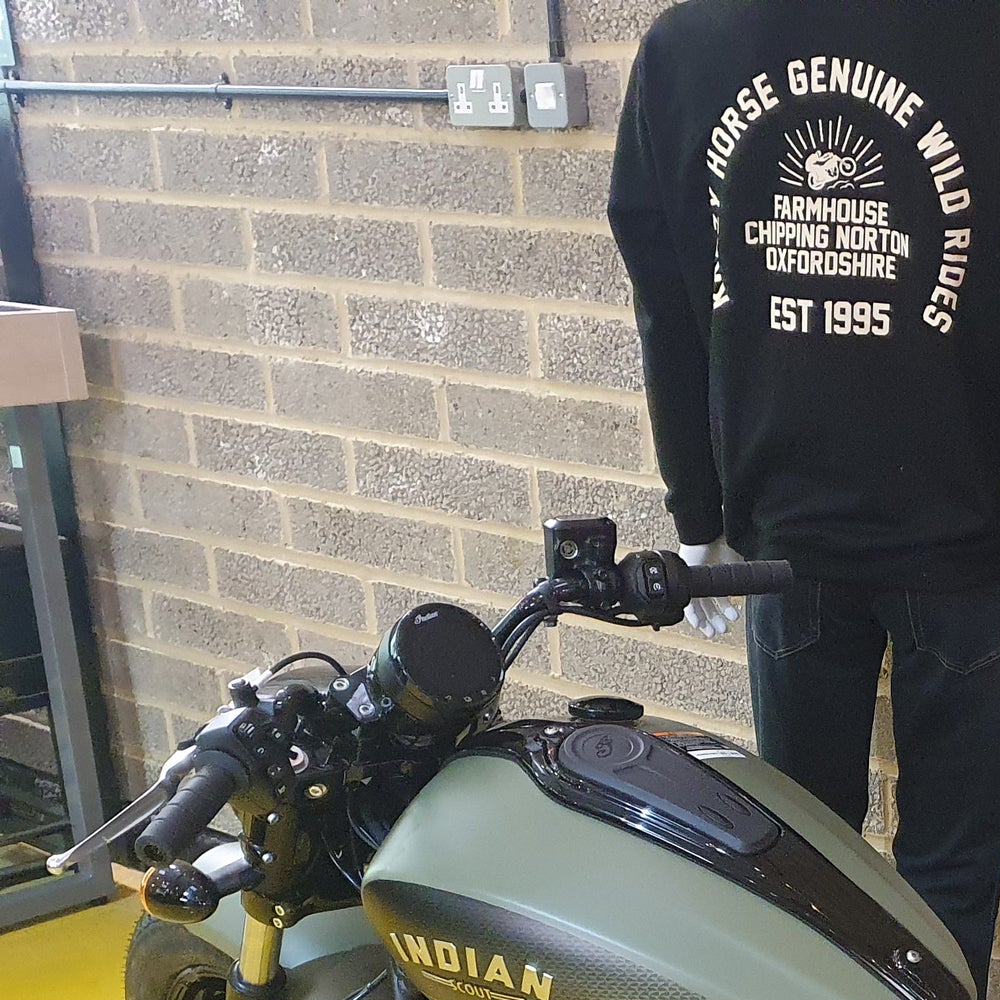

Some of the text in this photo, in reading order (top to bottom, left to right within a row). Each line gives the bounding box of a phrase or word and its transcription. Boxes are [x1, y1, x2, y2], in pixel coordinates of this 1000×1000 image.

[706, 56, 971, 334] HORSE GENUINE WILD RIDES
[773, 194, 889, 227] FARMHOUSE
[744, 220, 910, 259] CHIPPING NORTON
[765, 246, 897, 280] OXFORDSHIRE
[770, 295, 891, 336] EST 1995
[450, 978, 492, 1000] SCOUT
